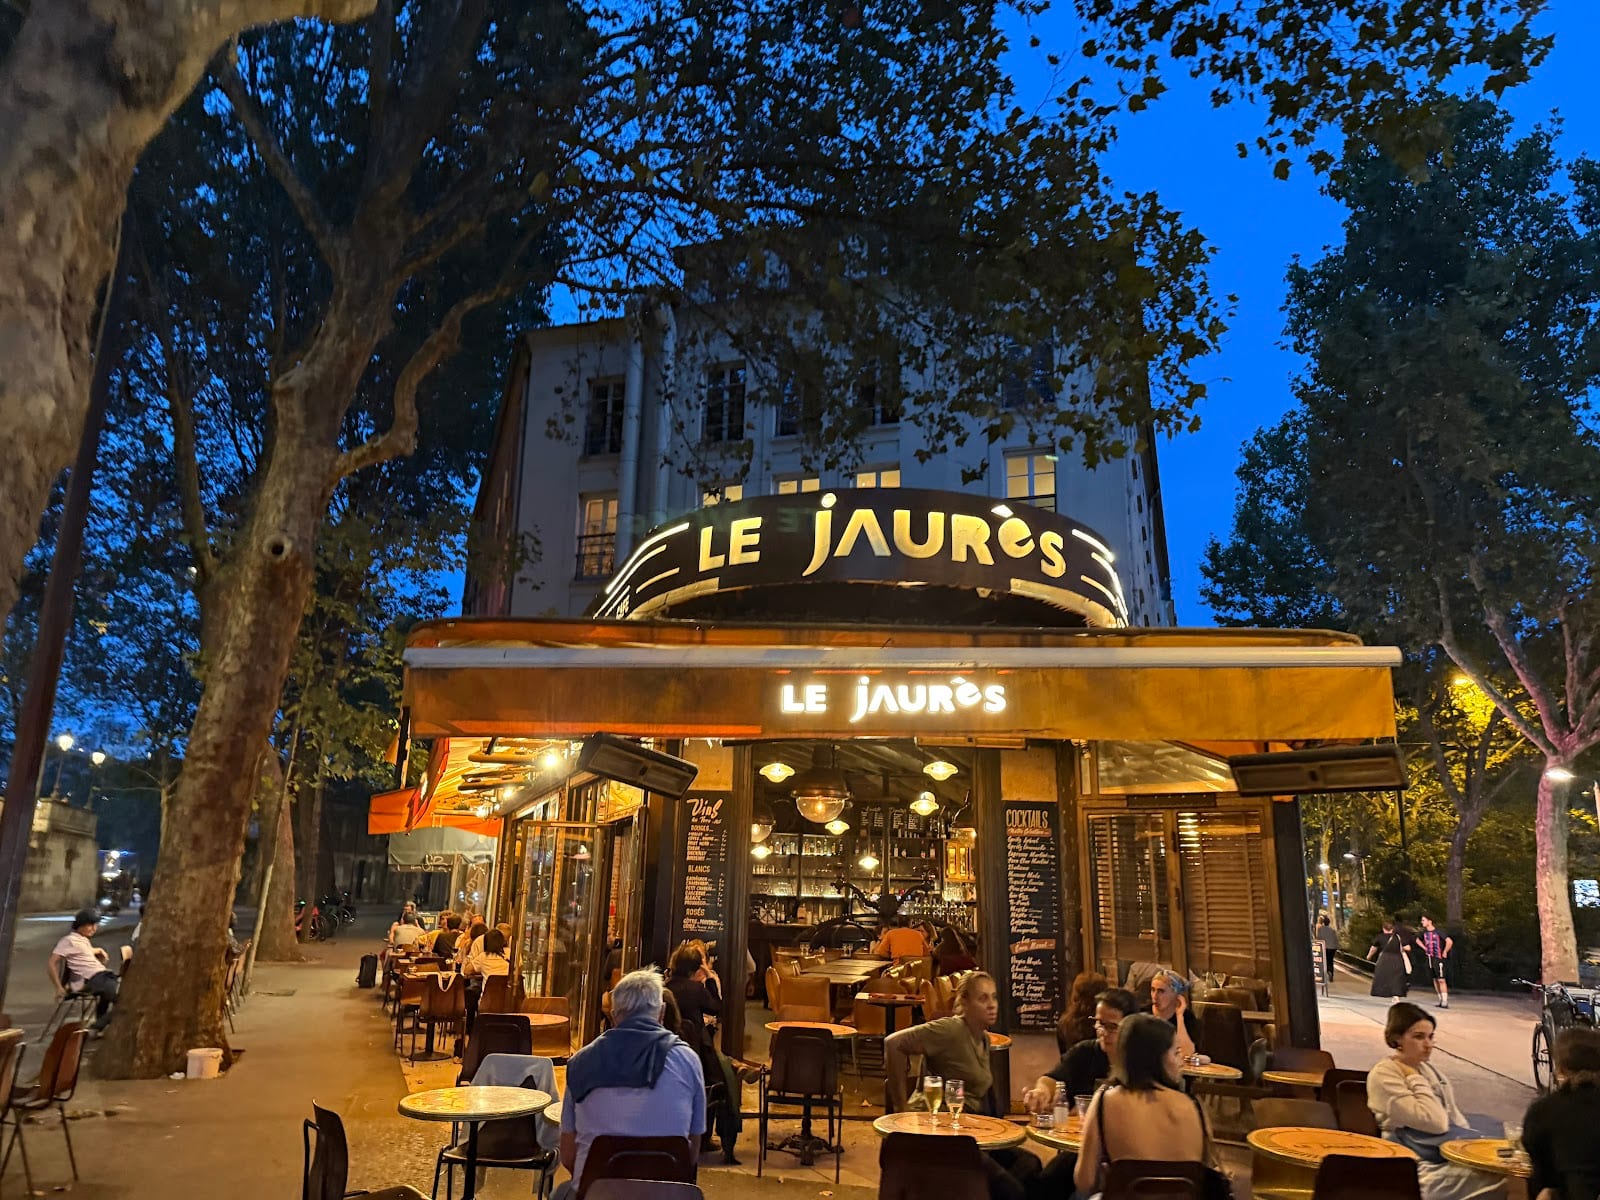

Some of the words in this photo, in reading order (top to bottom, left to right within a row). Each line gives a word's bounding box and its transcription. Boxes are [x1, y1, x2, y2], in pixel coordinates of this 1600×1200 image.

[698, 515, 763, 572] LE
[781, 683, 827, 713] LE
[1005, 808, 1049, 829] COCKTAILS
[687, 864, 711, 873] BLANCS
[685, 906, 706, 916] ROSÉS
